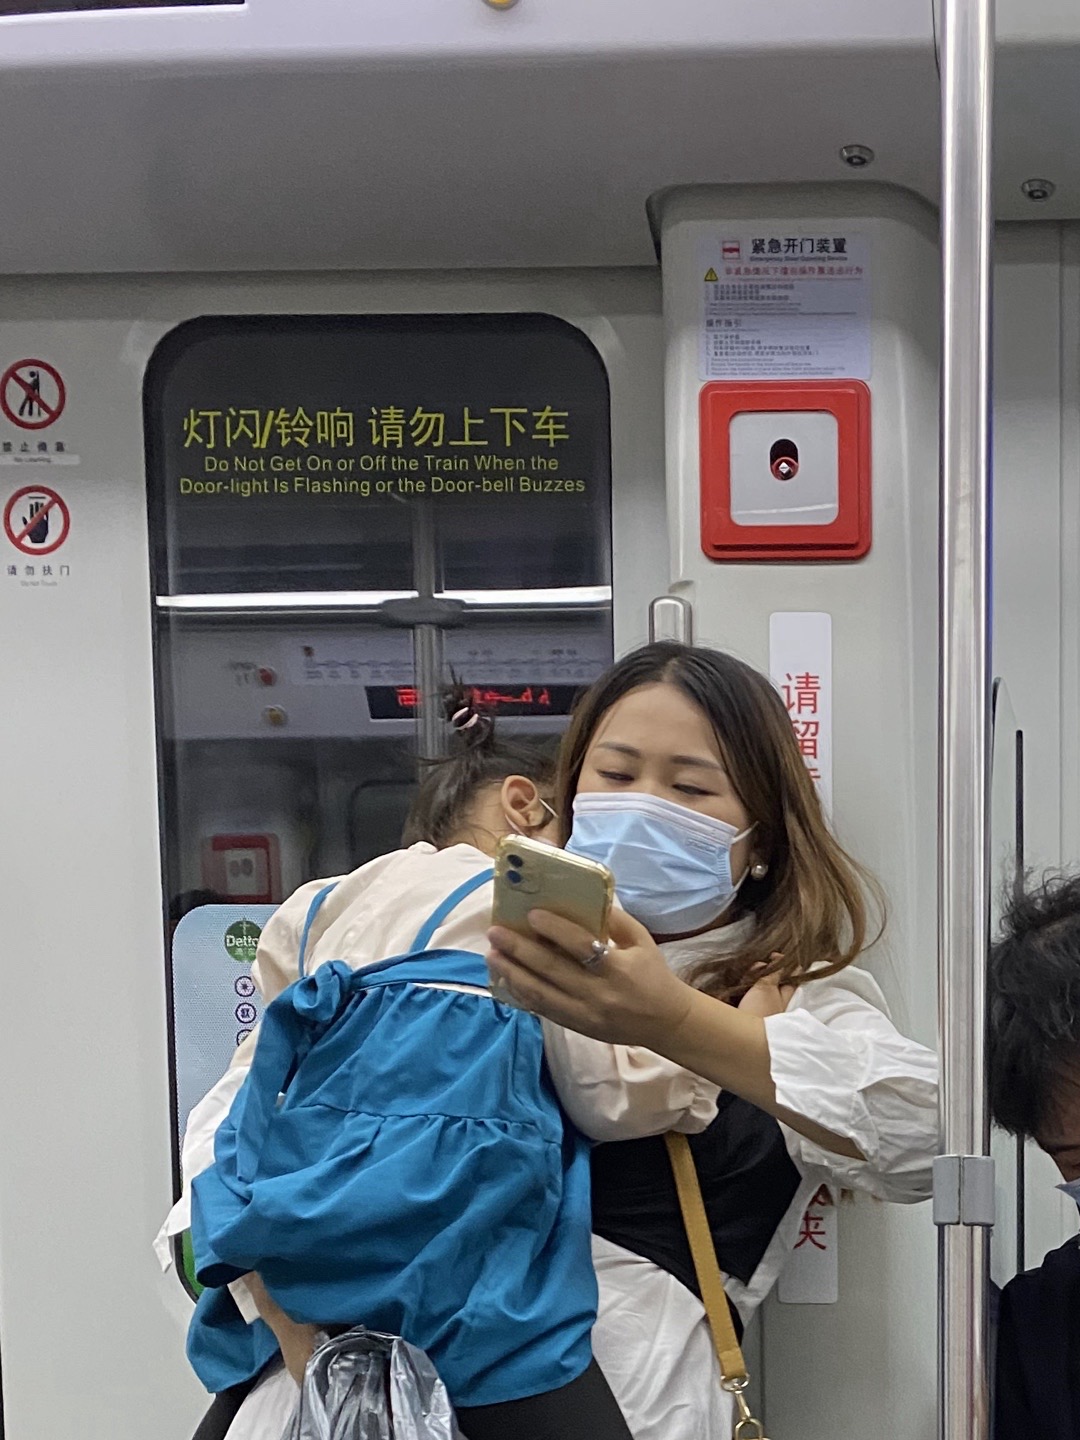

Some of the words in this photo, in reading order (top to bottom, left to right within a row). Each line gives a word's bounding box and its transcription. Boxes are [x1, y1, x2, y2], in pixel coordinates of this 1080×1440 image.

[751, 238, 848, 254] 紧急开门装置
[183, 407, 354, 448] 灯闪/铃响
[369, 406, 569, 448] 请勿上下车
[204, 456, 229, 472] Do
[234, 456, 265, 472] Not
[270, 456, 302, 472] Get
[306, 456, 332, 471] On
[337, 459, 355, 471] or
[360, 455, 387, 471] Off
[391, 456, 419, 471] the
[424, 454, 469, 471] Train
[473, 455, 525, 470] When
[530, 455, 559, 470] the
[179, 478, 270, 497] Door-light
[273, 478, 289, 494] Is
[294, 477, 370, 496] Flashing
[375, 481, 393, 493] or
[398, 478, 426, 493] the
[431, 477, 514, 493] Door-bell
[519, 476, 585, 492] Buzzes
[7, 565, 70, 577] 请勿扶门
[782, 672, 821, 780] 请留
[226, 934, 260, 948] Detto
